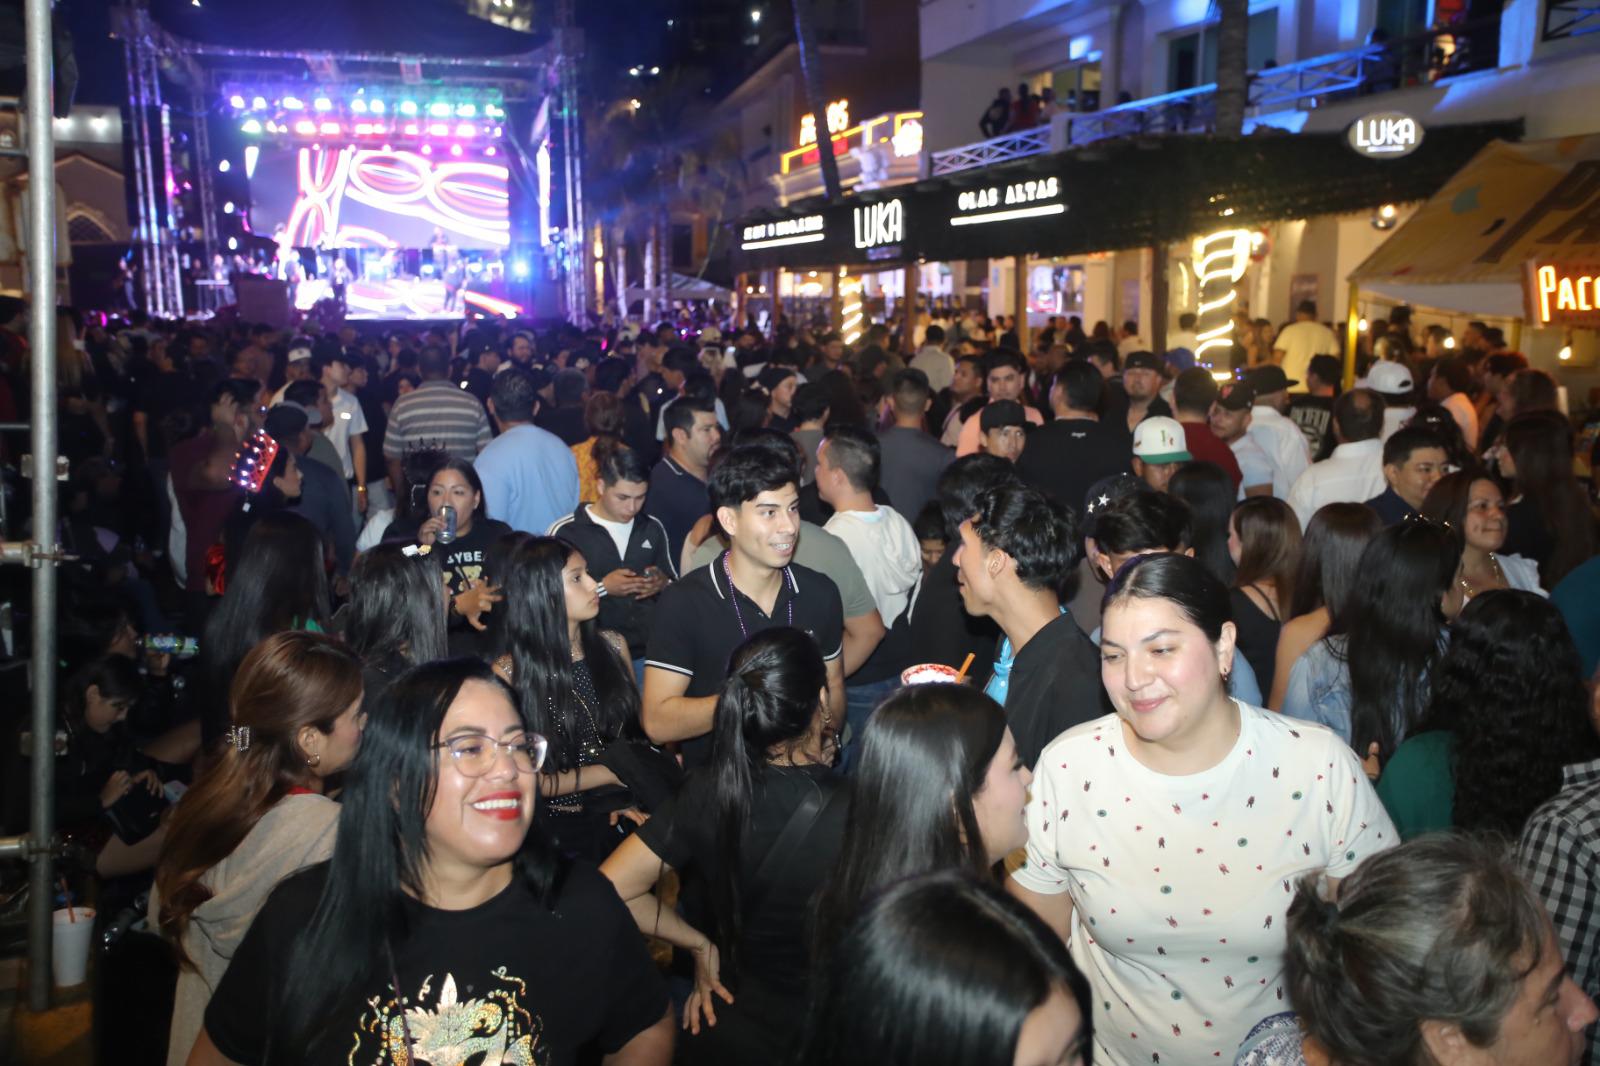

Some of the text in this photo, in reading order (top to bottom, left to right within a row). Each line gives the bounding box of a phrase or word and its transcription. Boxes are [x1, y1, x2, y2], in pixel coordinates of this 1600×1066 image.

[1356, 117, 1416, 147] LUKA
[1005, 177, 1058, 204] ALTAS
[853, 198, 903, 249] LUKA
